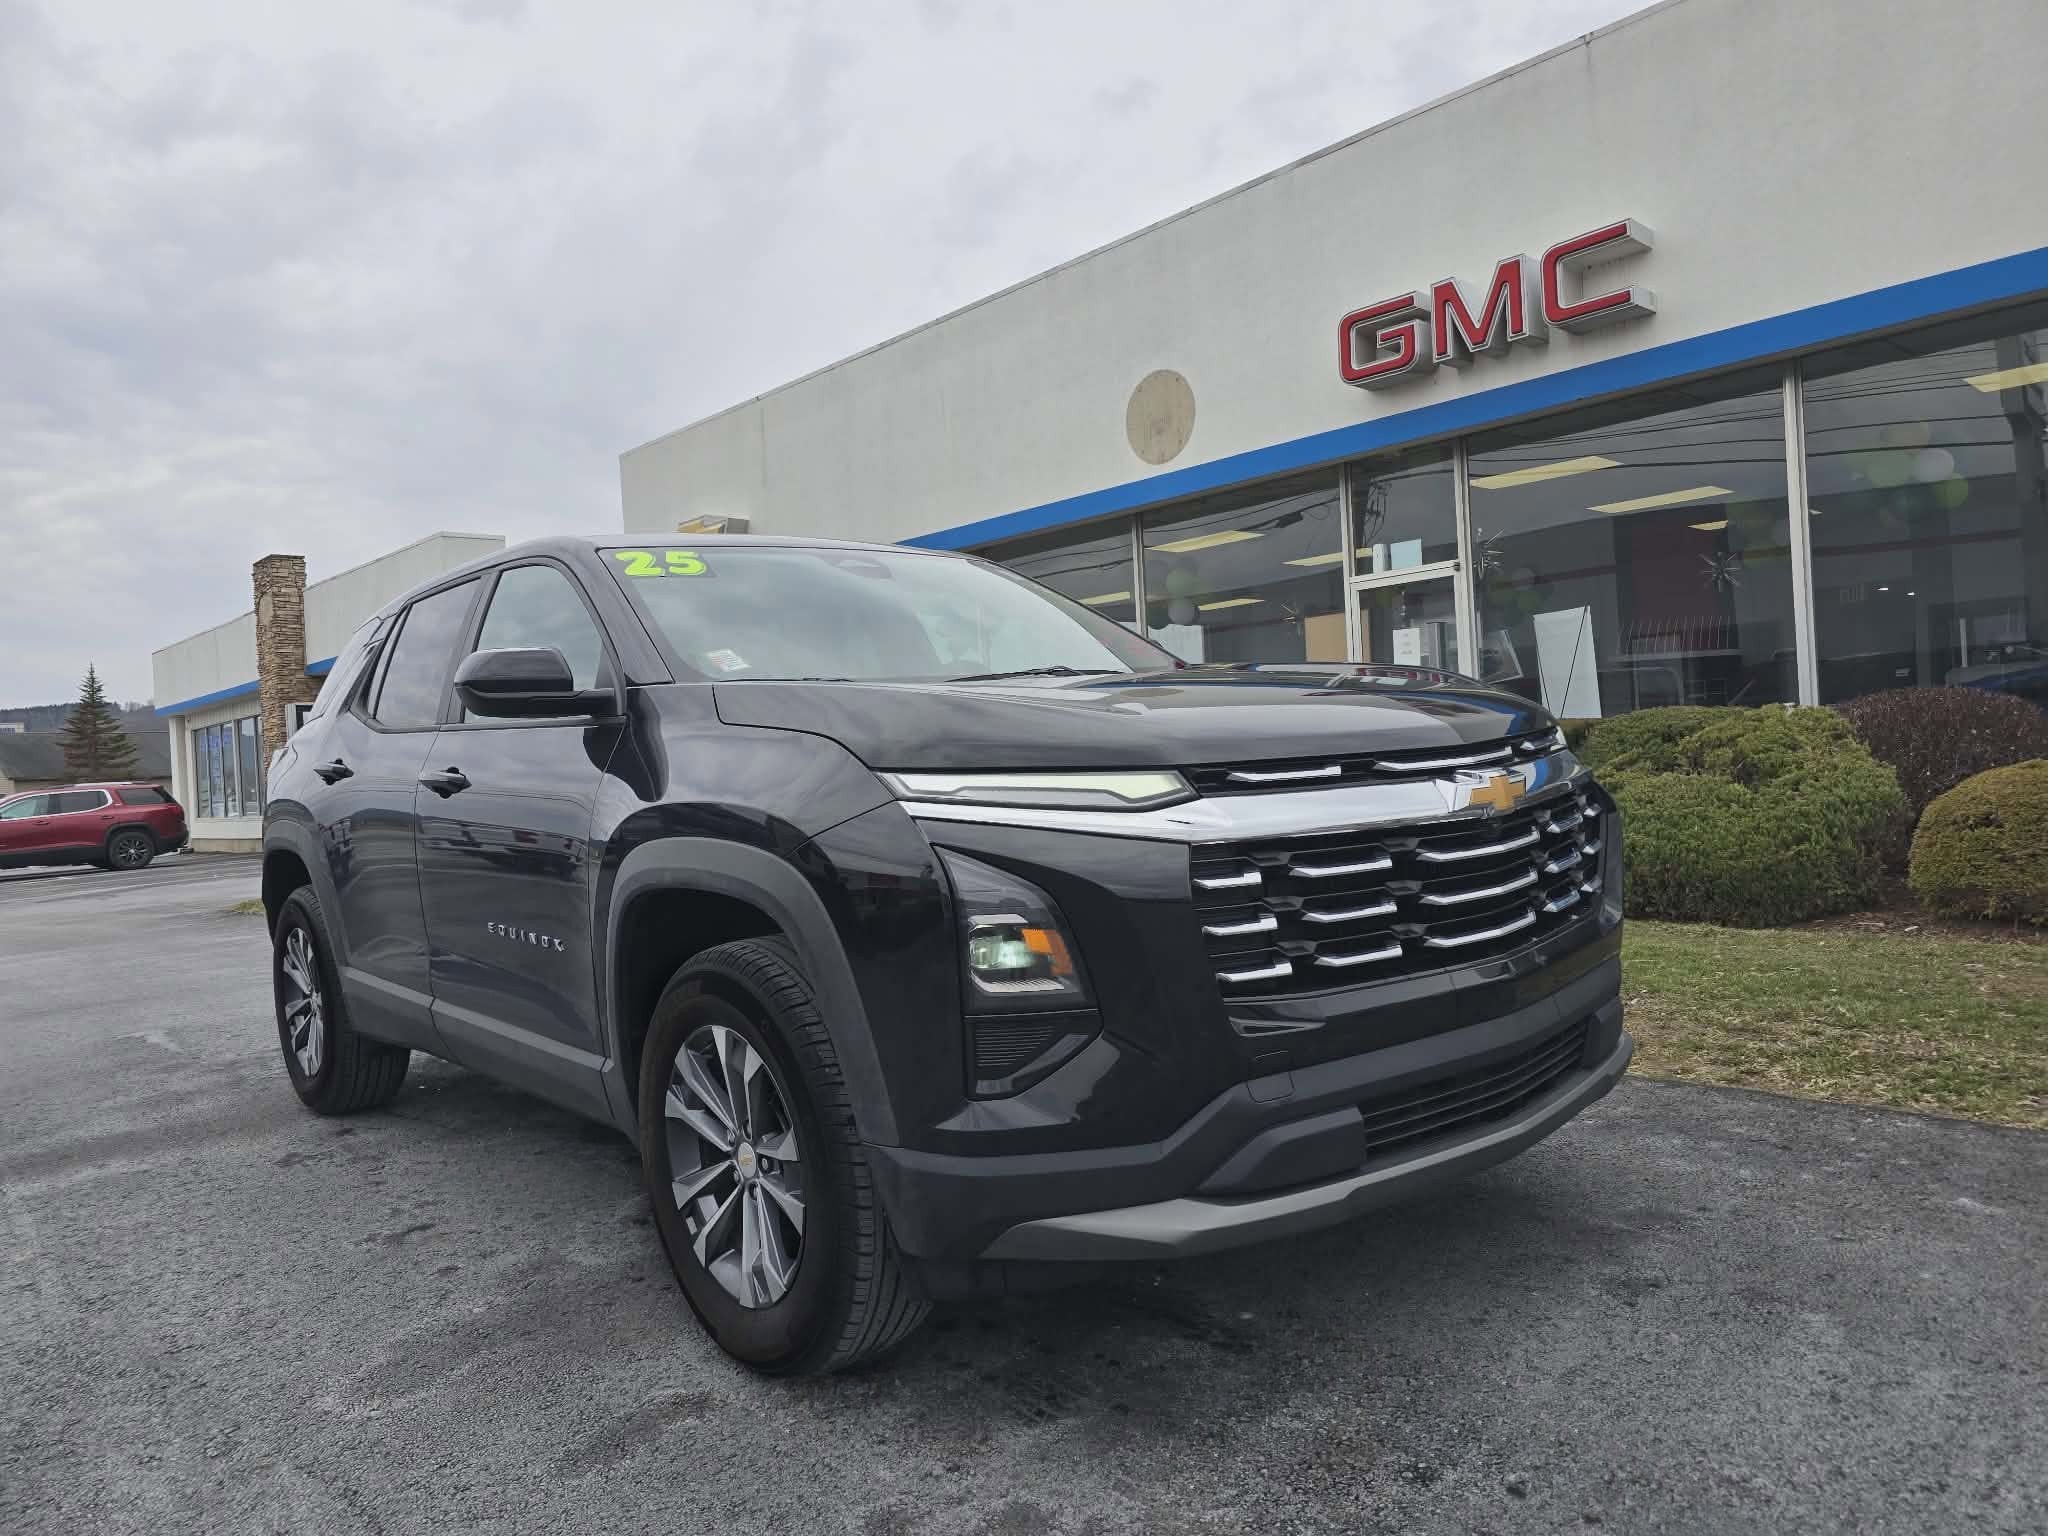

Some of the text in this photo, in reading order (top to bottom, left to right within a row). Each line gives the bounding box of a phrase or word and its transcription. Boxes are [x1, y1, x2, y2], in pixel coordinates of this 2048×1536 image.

[1338, 217, 1655, 389] GMC
[614, 550, 708, 577] 25
[487, 921, 566, 952] EQUINOX
